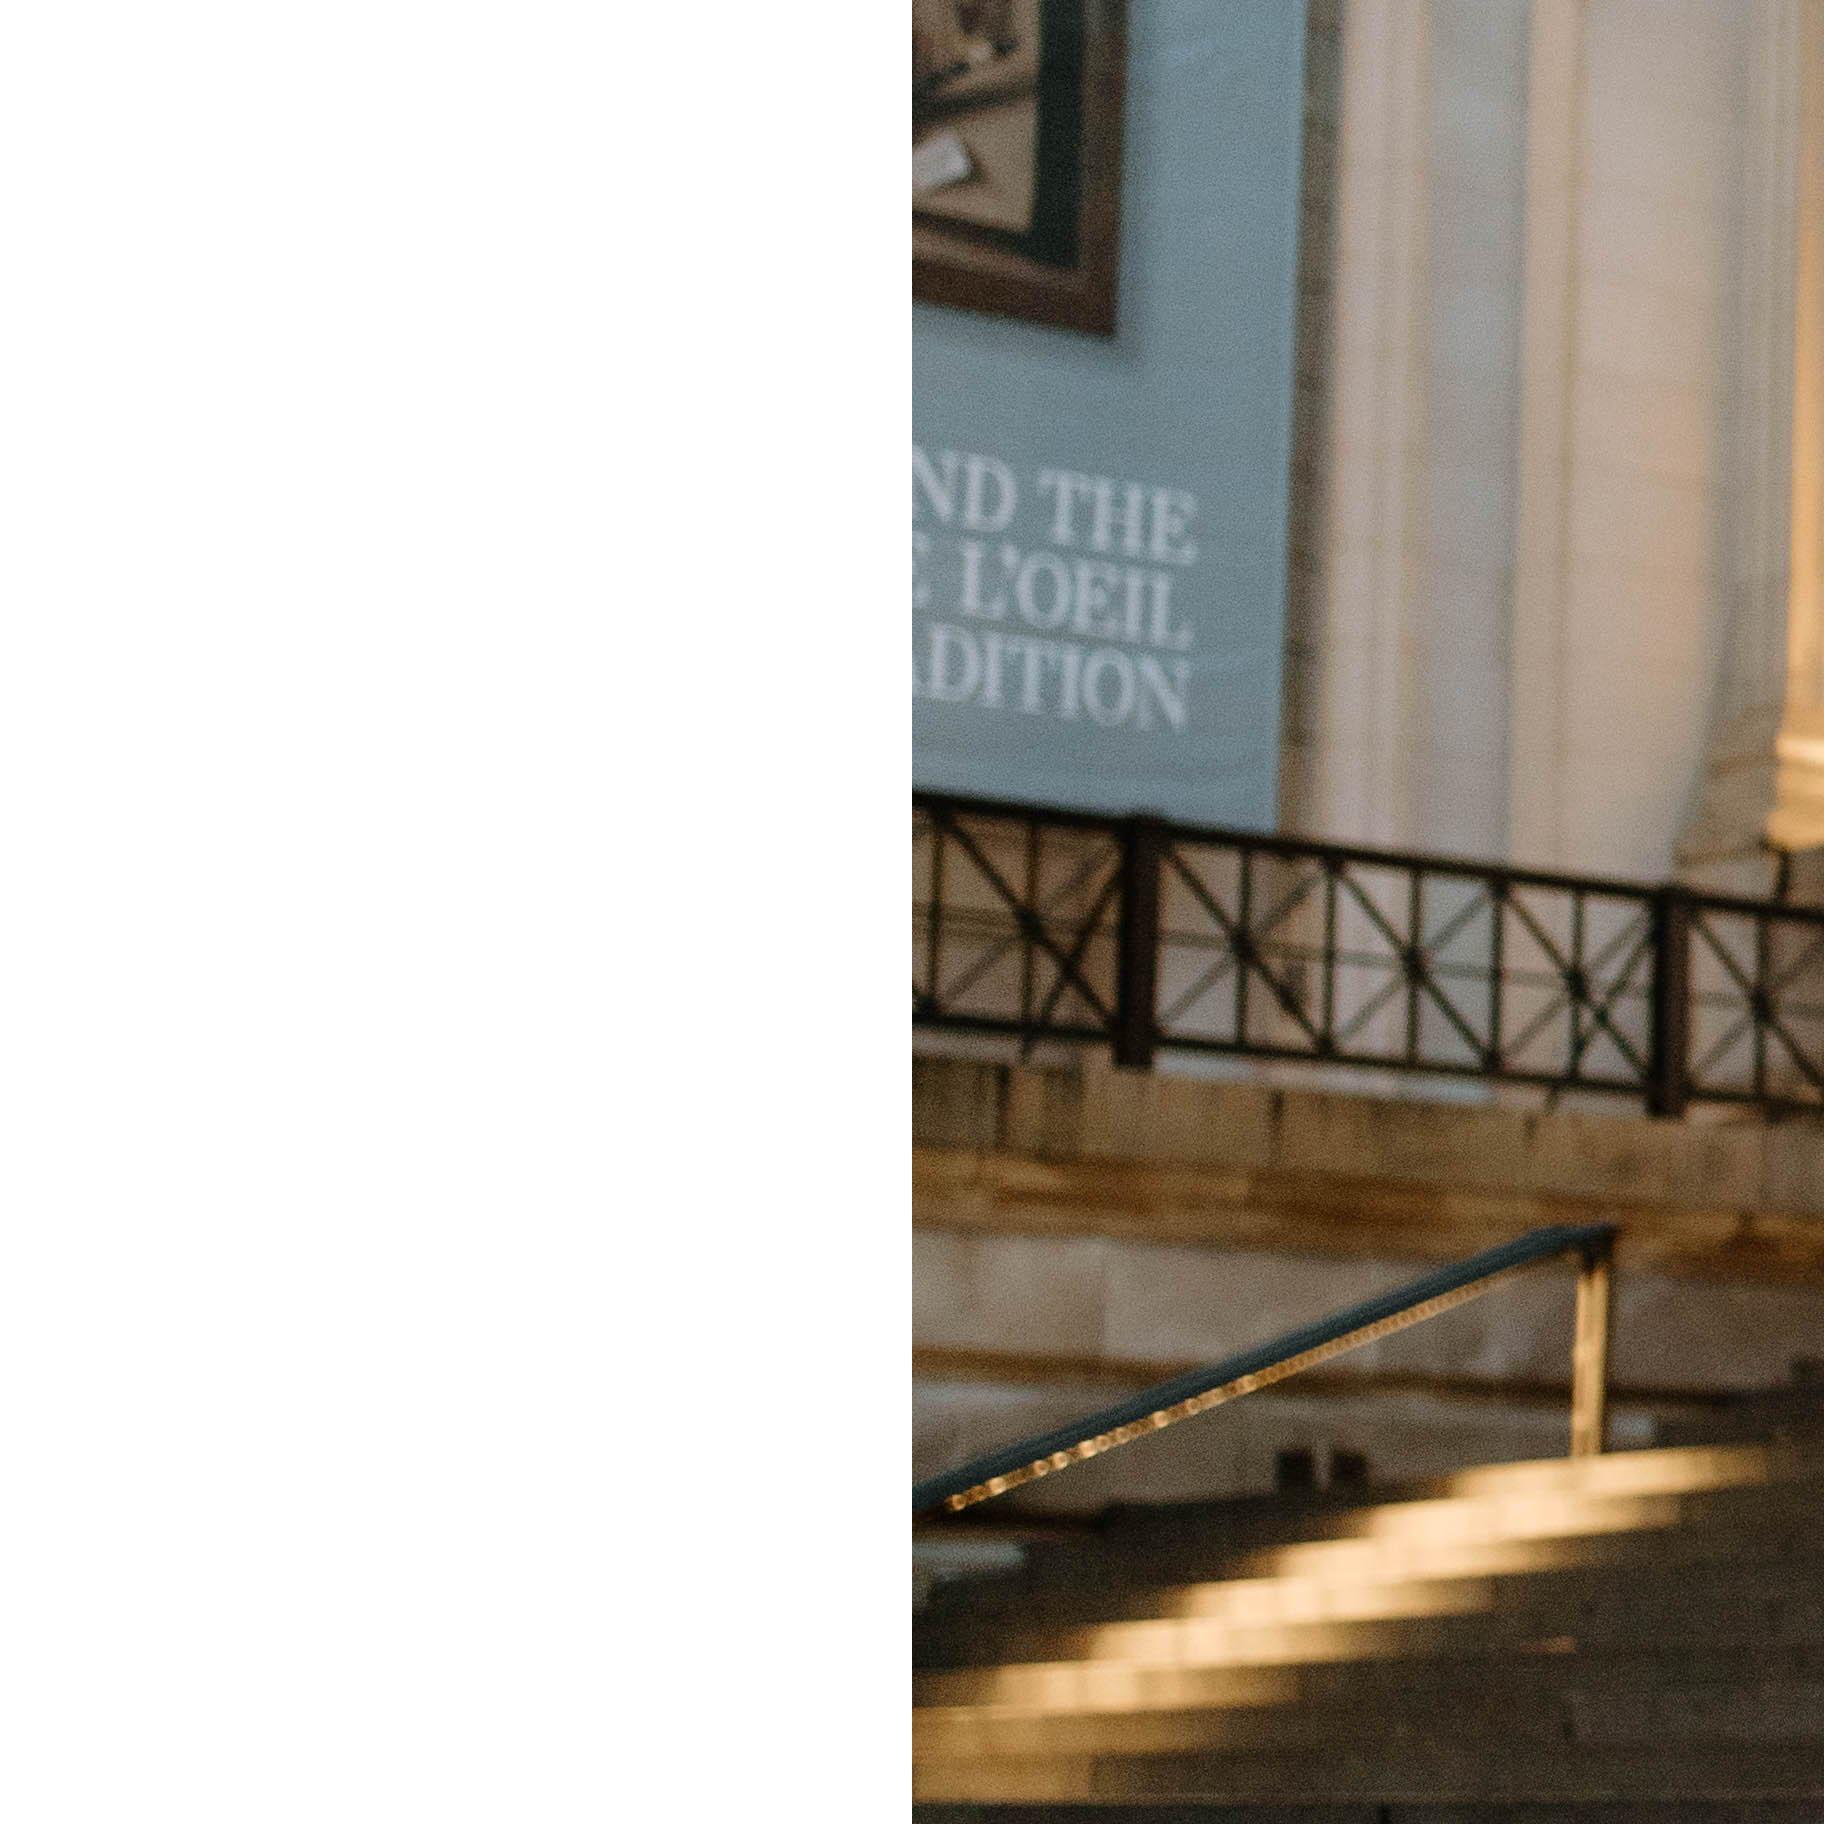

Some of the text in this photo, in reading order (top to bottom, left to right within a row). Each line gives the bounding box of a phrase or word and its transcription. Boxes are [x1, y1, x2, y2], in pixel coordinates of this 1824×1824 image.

[1036, 467, 1199, 568] THE
[961, 539, 1193, 651] L'OEIL
[912, 622, 1190, 733] DITION
